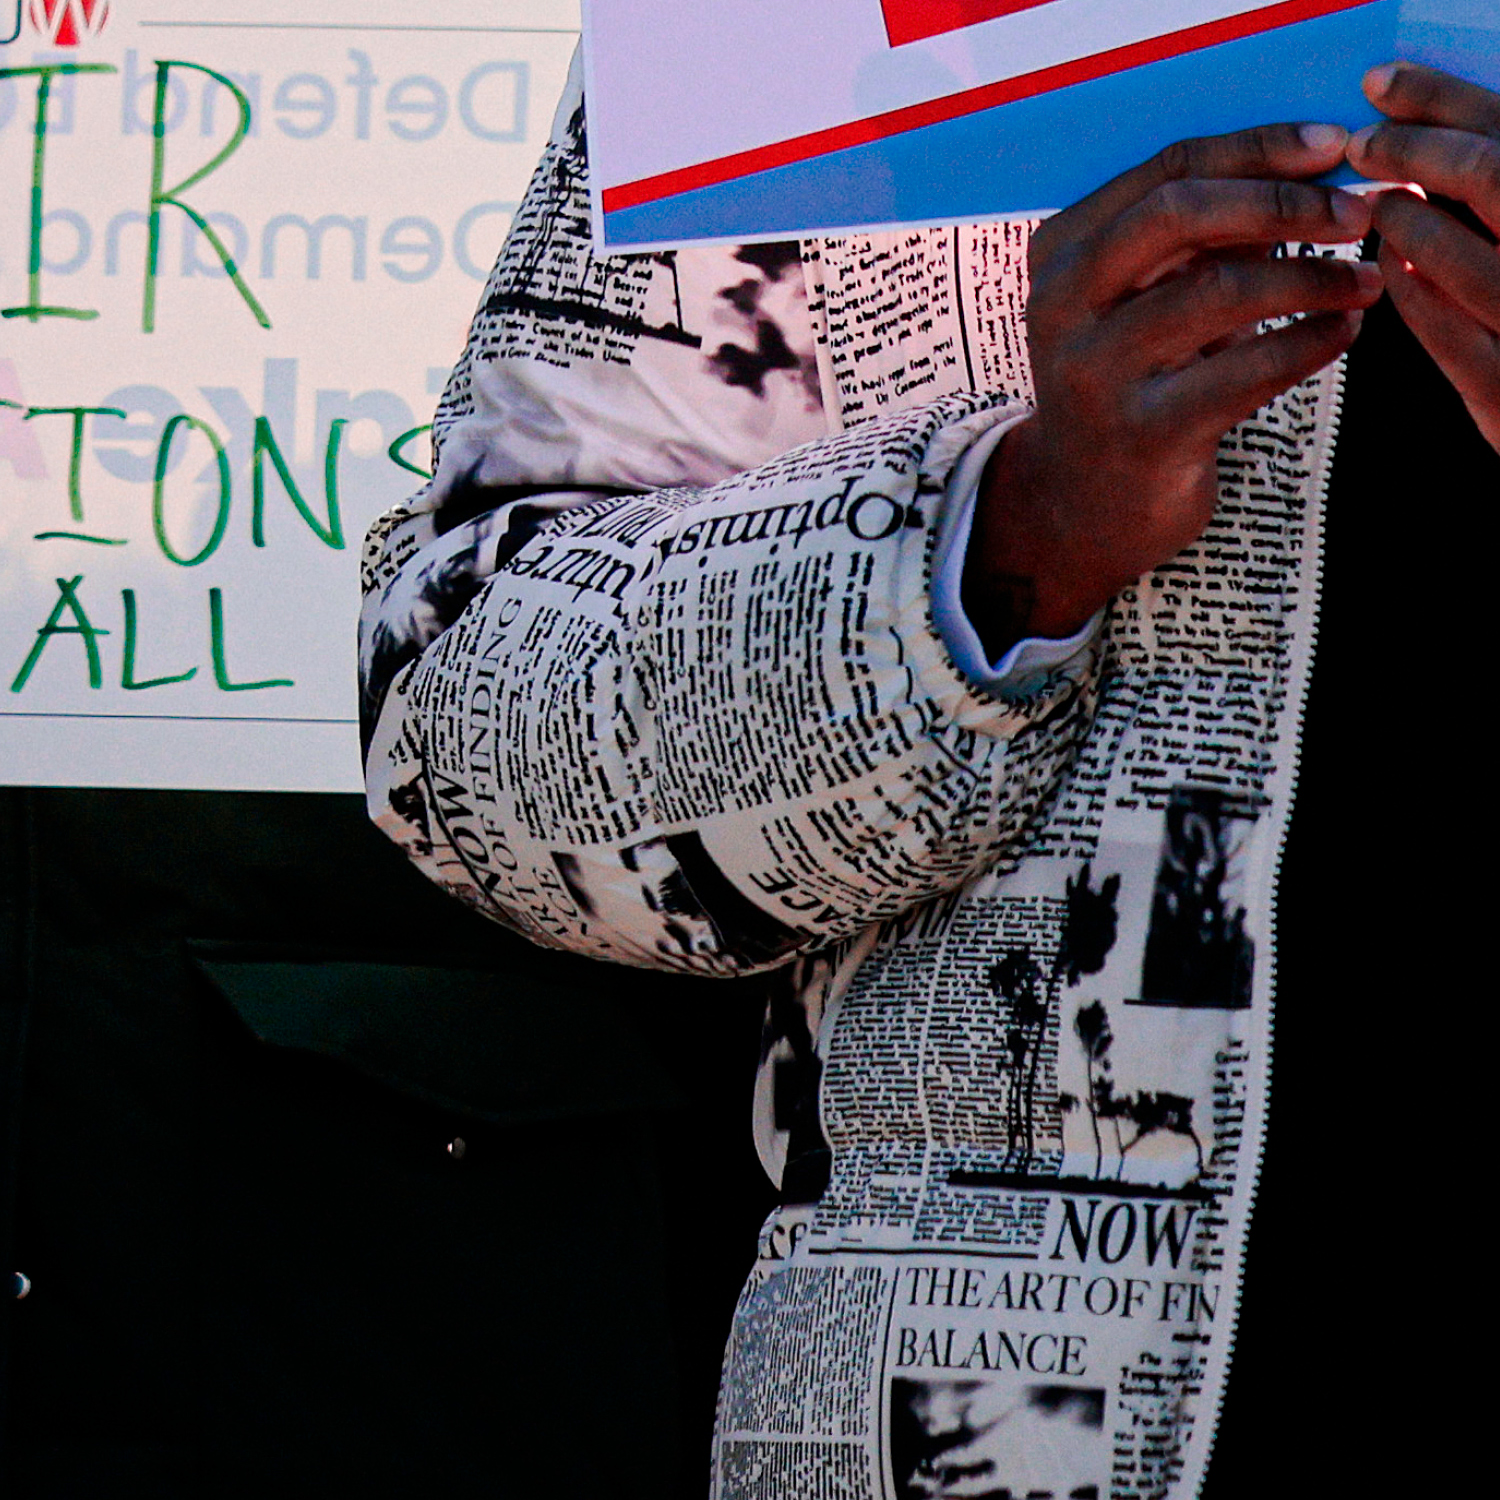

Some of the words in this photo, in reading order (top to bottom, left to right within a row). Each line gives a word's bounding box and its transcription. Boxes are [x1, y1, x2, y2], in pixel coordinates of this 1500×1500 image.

[11, 574, 294, 692] ALL
[469, 597, 523, 805] FINDING
[1048, 1199, 1200, 1270] NOW
[905, 1267, 987, 1307] THE
[994, 1271, 1081, 1313] ART
[1084, 1275, 1152, 1322] OF
[896, 1327, 1089, 1377] BALANCE
